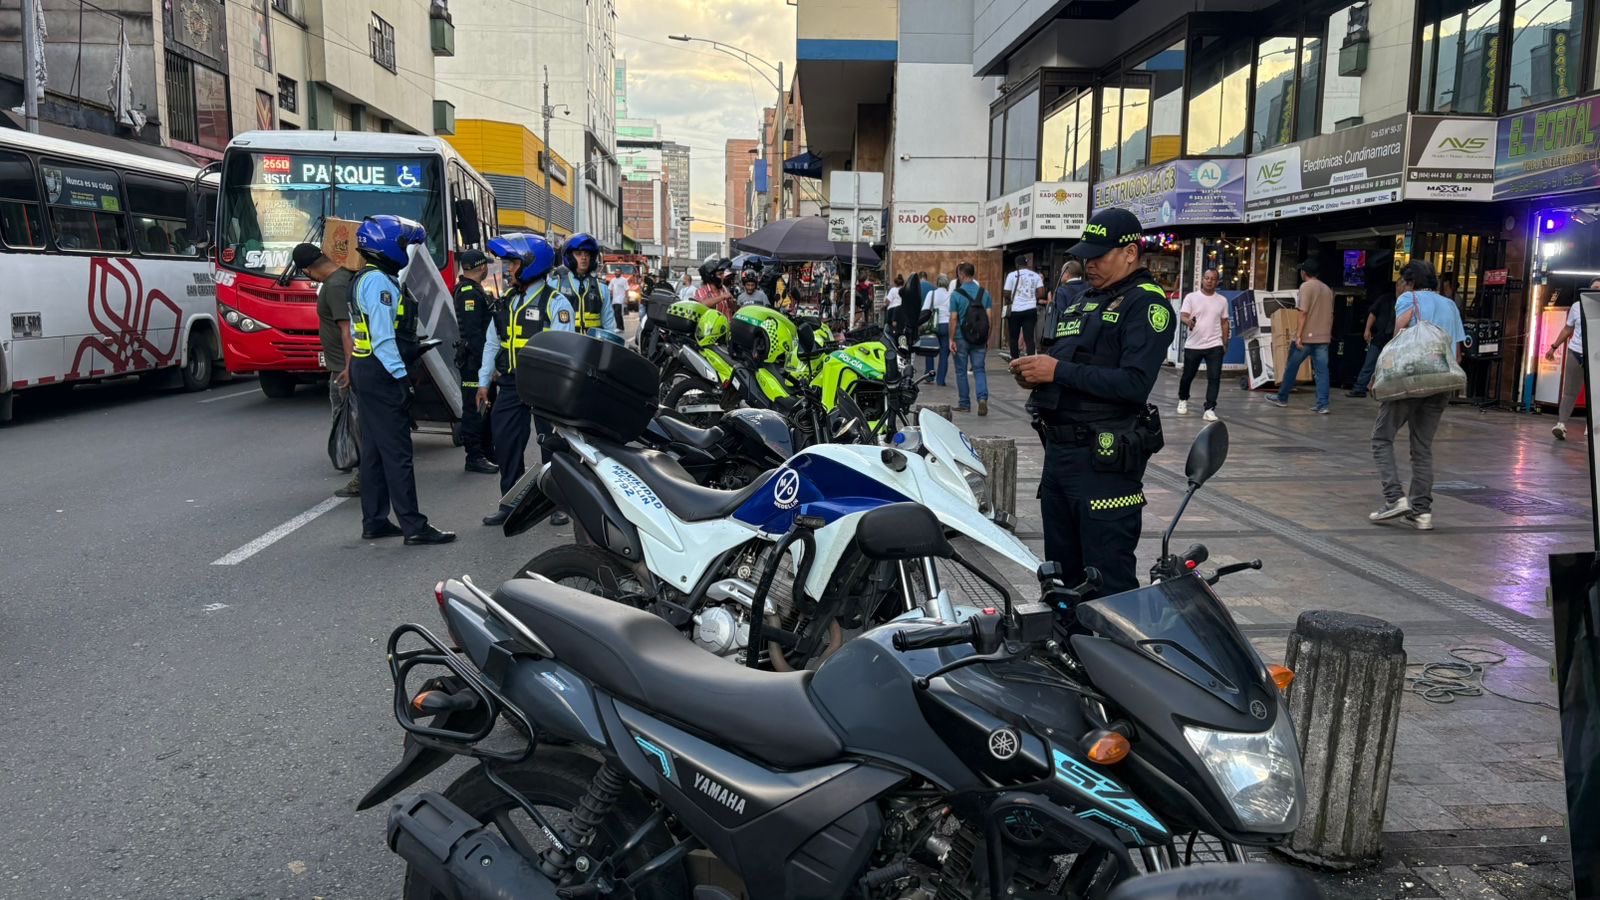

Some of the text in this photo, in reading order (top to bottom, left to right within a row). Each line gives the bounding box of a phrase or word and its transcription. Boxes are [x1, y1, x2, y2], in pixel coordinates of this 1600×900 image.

[1509, 101, 1594, 158] EL PORTAL
[1438, 137, 1489, 149] AVS
[1303, 142, 1401, 173] Electrónicas Cundinamarca
[302, 163, 385, 184] PARQUE
[1164, 166, 1176, 192] 53
[1200, 168, 1219, 180] AL
[1257, 160, 1286, 181] AVS
[937, 215, 976, 224] CENTRO
[245, 250, 290, 268] SAN
[1057, 319, 1081, 331] OLICÍA
[838, 353, 864, 370] POLICÍA
[612, 465, 663, 509] MOVILIDAD
[615, 478, 635, 497] 792
[693, 772, 746, 815] YAMAHA
